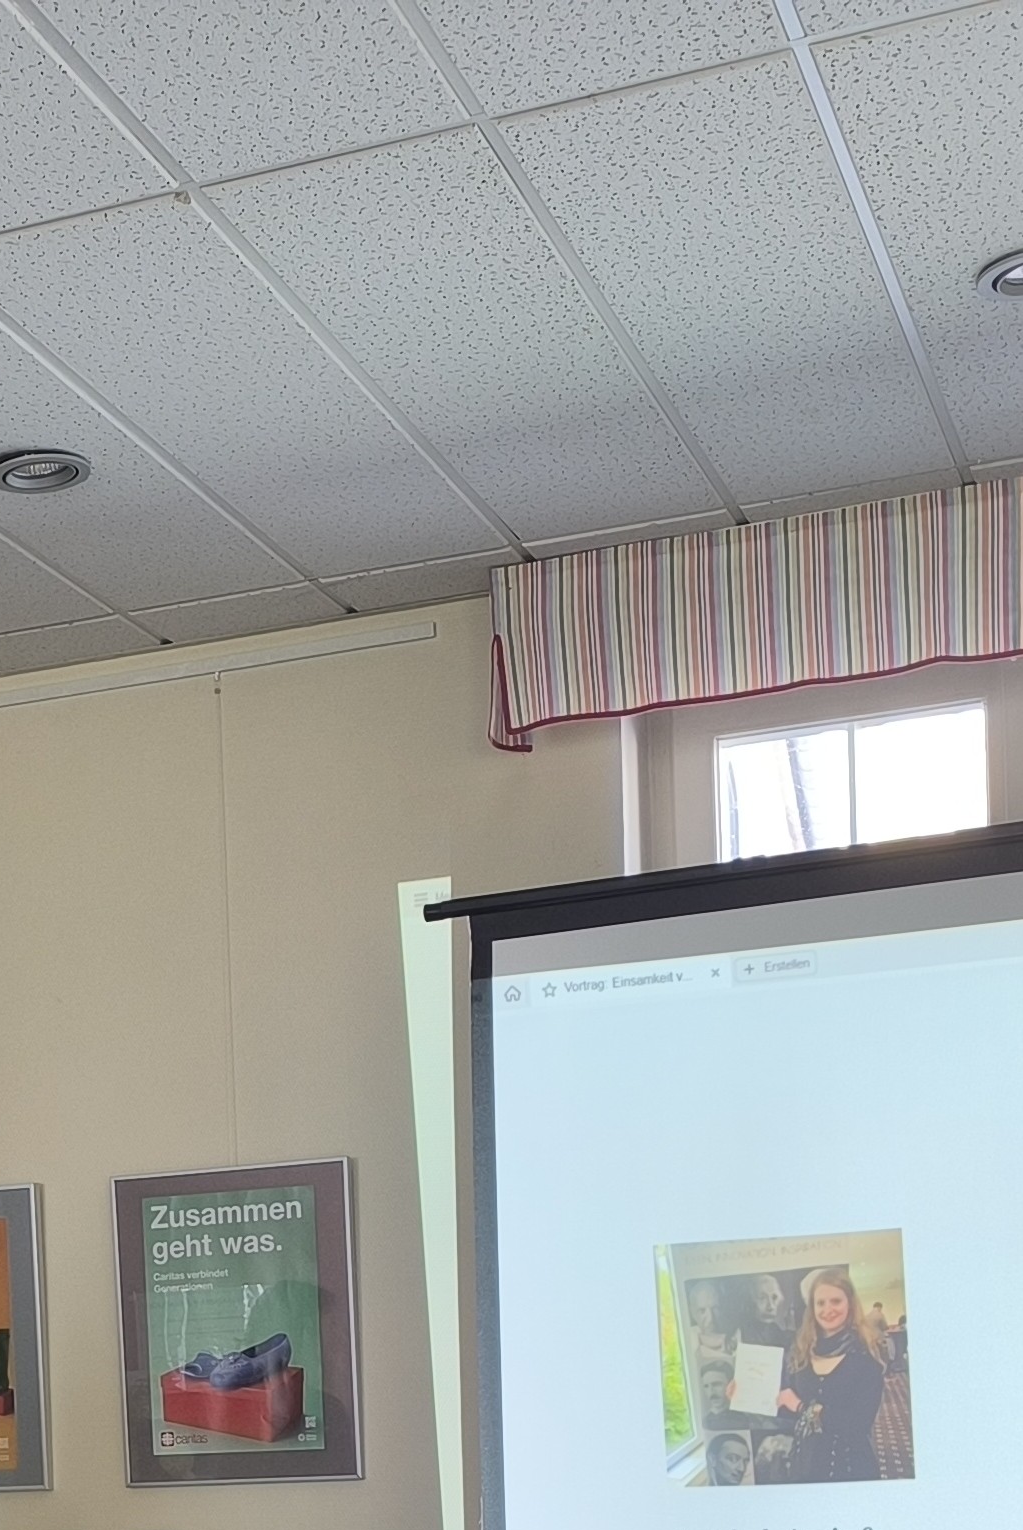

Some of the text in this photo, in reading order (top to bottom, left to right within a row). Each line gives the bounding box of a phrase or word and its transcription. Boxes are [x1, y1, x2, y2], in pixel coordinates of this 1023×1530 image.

[763, 957, 811, 973] Erstellen
[612, 971, 674, 989] Einsamkeit
[150, 1200, 302, 1229] Zusammen
[152, 1234, 282, 1265] geht was.
[153, 1268, 229, 1282] Caritas verbindet
